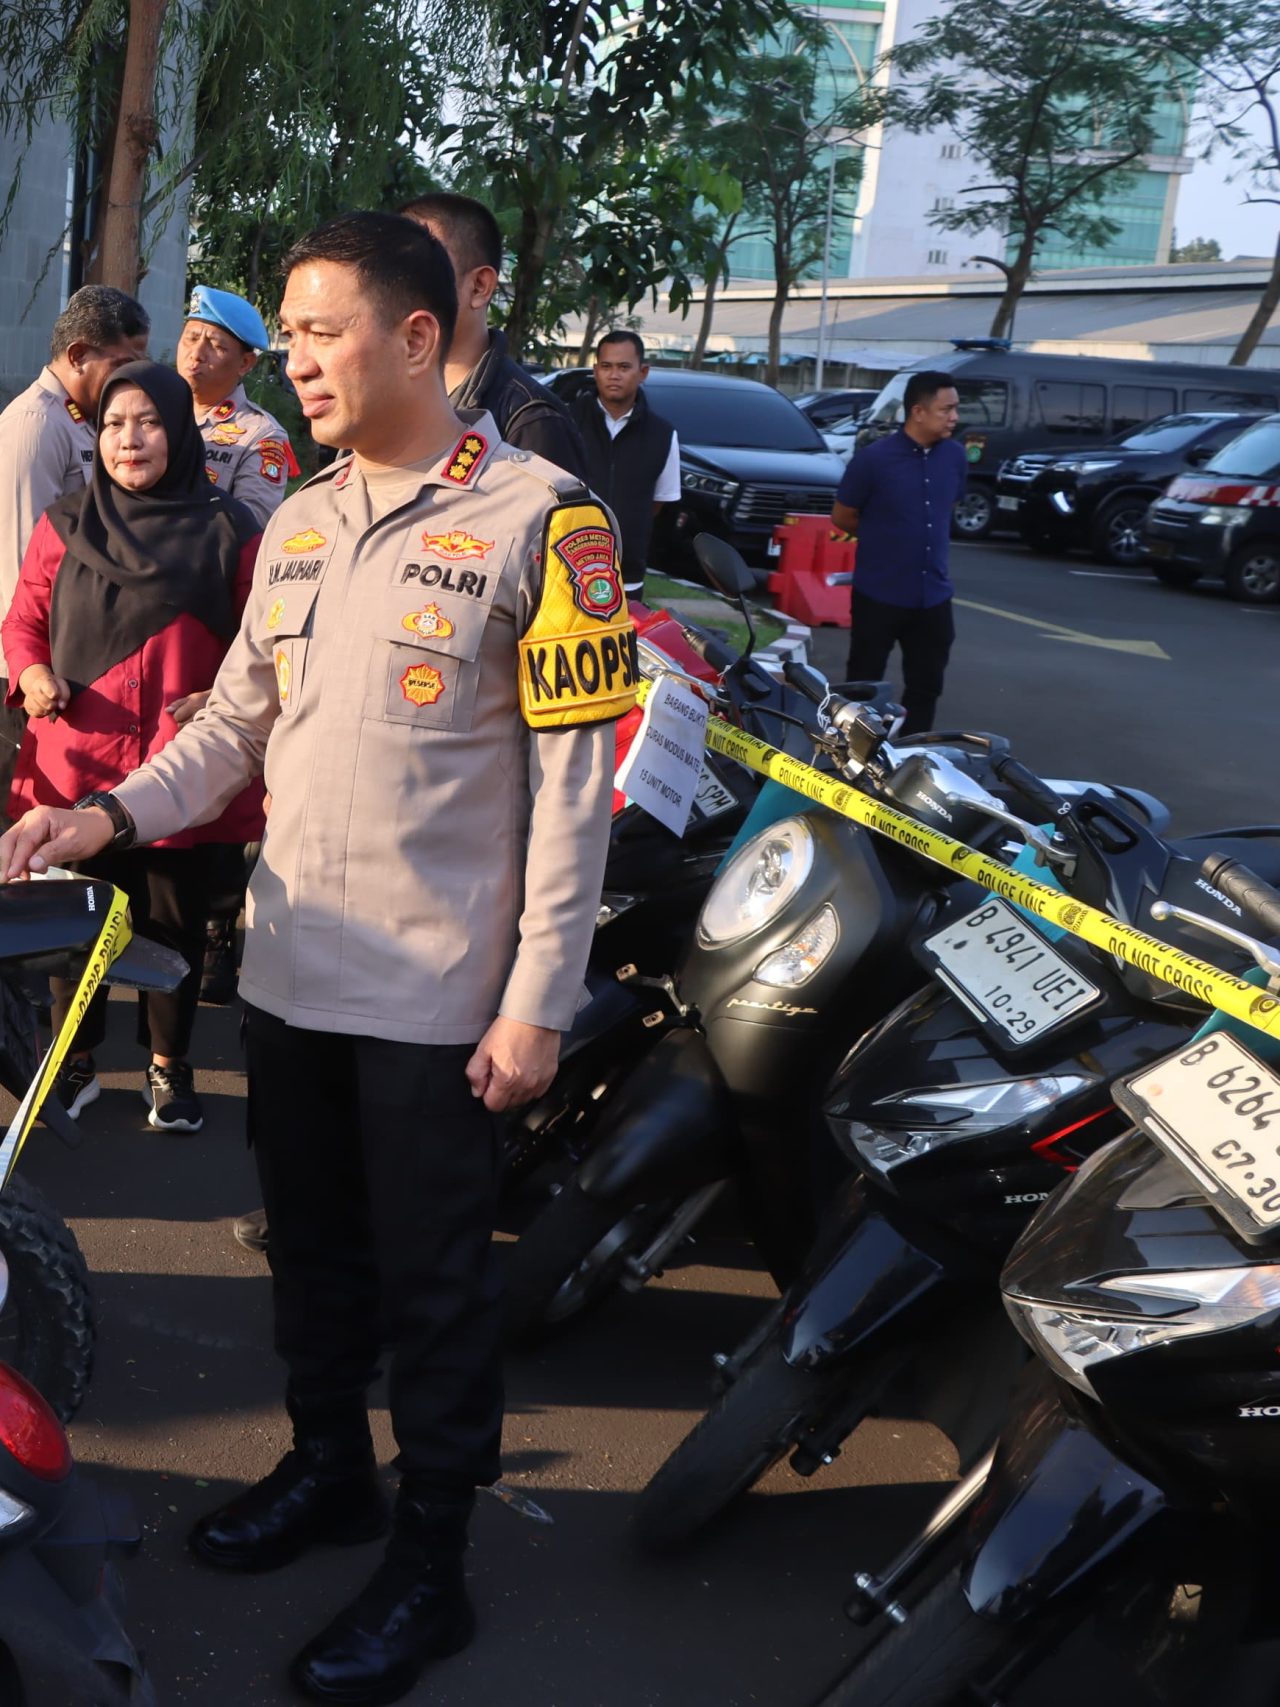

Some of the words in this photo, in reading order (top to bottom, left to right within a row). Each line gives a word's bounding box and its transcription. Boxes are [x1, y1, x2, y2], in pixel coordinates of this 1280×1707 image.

[400, 563, 487, 598] POLRI
[664, 693, 690, 717] BARANG
[646, 725, 664, 747] CURAS
[664, 738, 686, 761] MODUS
[712, 732, 726, 752] NOT
[726, 737, 749, 764] CROSS
[640, 768, 648, 781] 15
[646, 773, 662, 791] UNIT
[662, 781, 683, 807] MOTOR
[778, 767, 806, 795] POLICE
[806, 780, 825, 801] LINE
[916, 790, 953, 823] HONDA
[878, 819, 897, 839] NOT
[86, 885, 96, 911] HONDA
[977, 869, 1018, 901] POLICE
[1019, 889, 1047, 917] LINE
[1193, 878, 1244, 917] HONDA
[966, 905, 999, 928] B
[985, 926, 1045, 973] 4941
[1032, 968, 1087, 1012] UEI
[1108, 936, 1129, 957] DO
[1131, 949, 1161, 975] NOT
[1163, 964, 1214, 1005] CROSS
[1179, 1040, 1220, 1066] B
[1207, 1065, 1280, 1131] 6264
